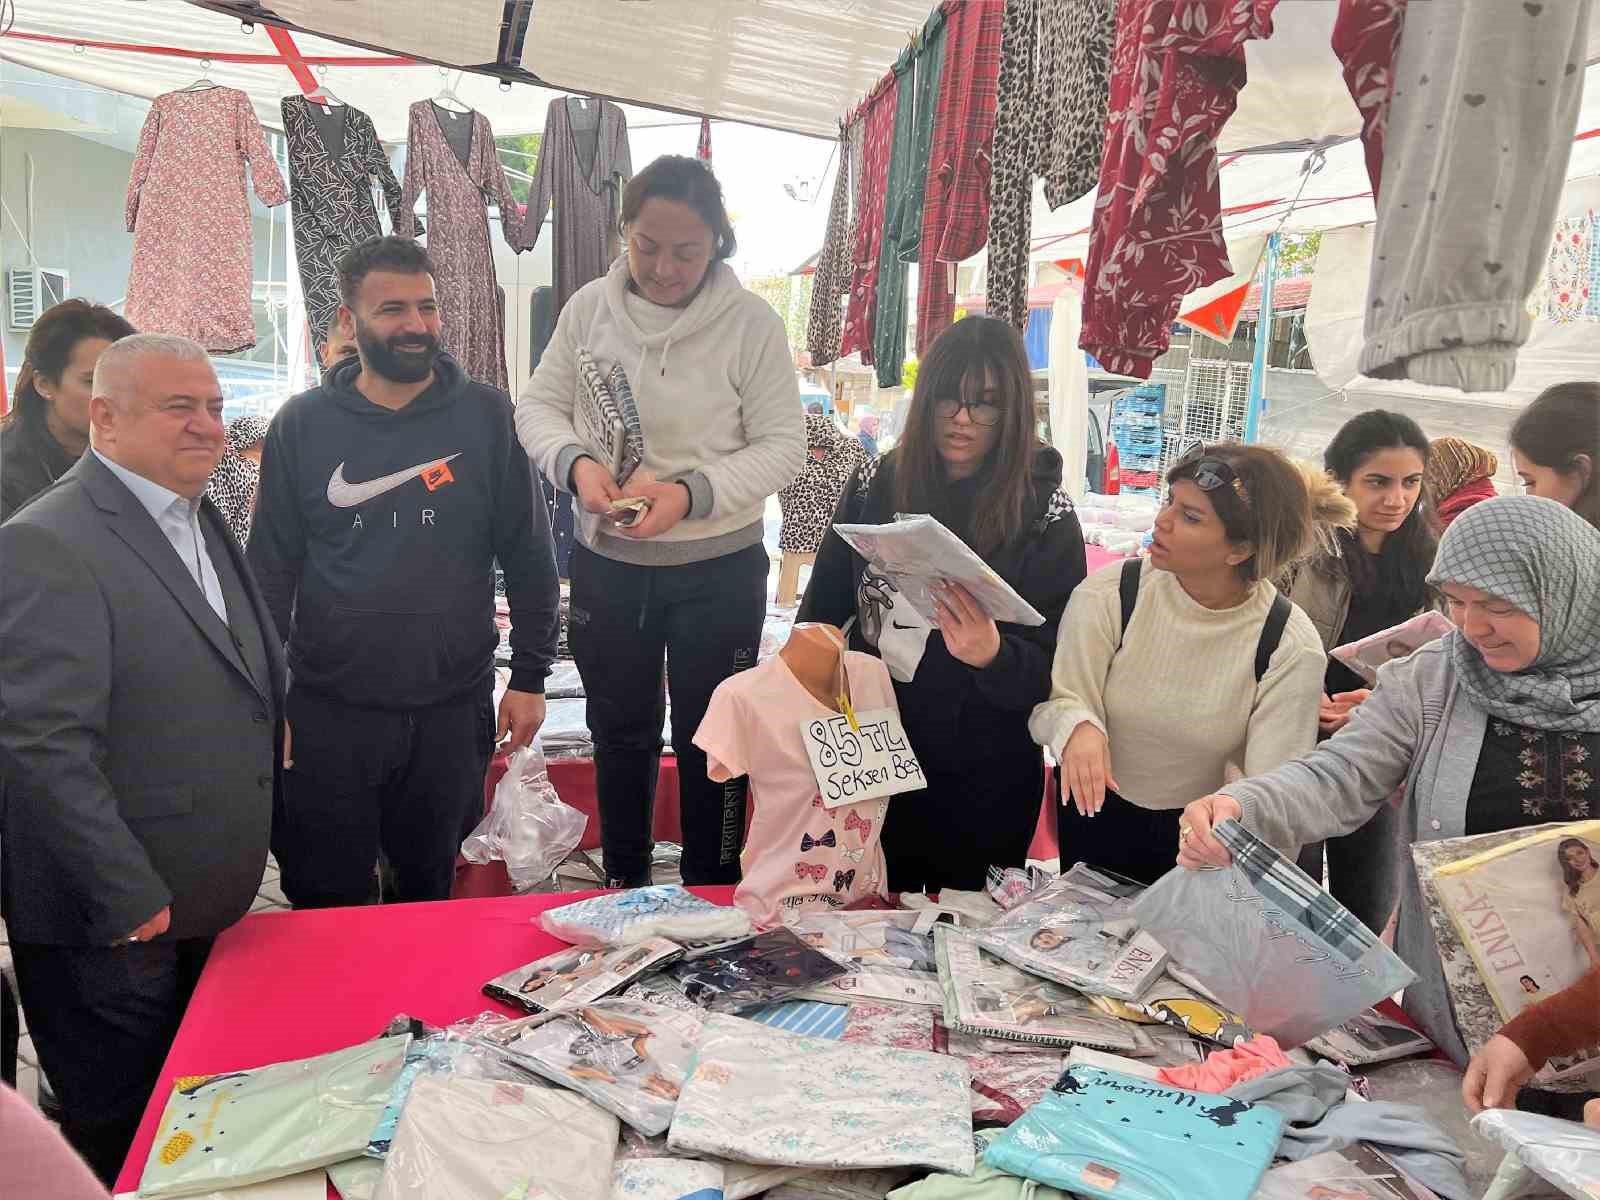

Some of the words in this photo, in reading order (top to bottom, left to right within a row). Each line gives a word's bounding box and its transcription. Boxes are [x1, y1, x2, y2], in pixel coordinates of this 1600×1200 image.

[352, 509, 435, 529] AIR
[809, 715, 862, 768] 85
[859, 720, 906, 752] TL
[1093, 1076, 1198, 1108] Unicorn
